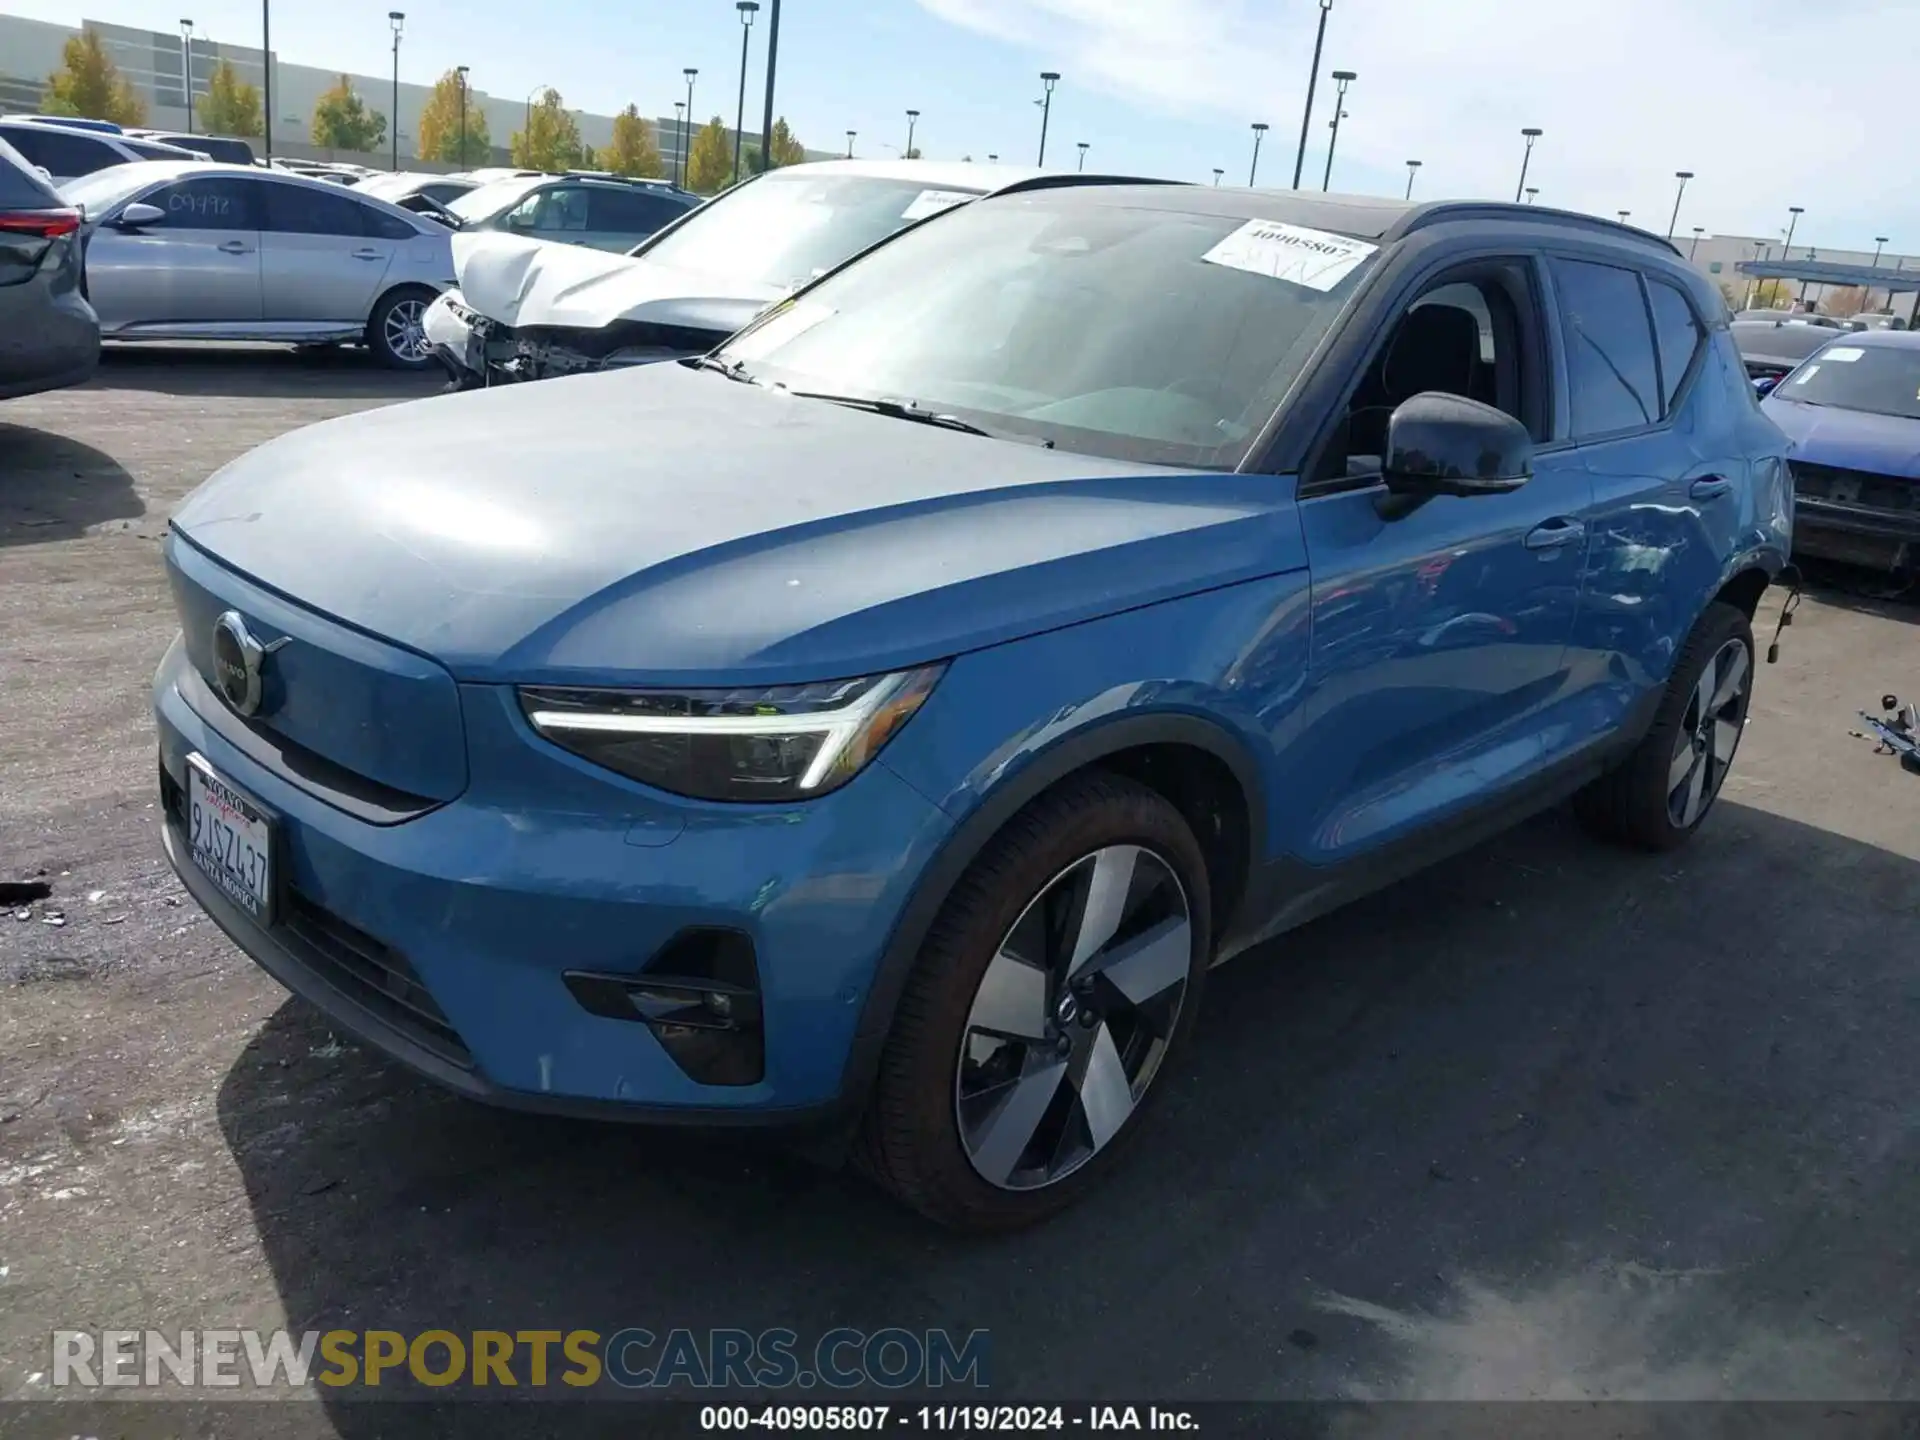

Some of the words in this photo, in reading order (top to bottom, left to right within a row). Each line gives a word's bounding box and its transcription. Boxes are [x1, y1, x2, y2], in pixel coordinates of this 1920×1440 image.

[192, 848, 221, 883] SANTA
[222, 871, 258, 916] MONICA
[193, 802, 267, 900] 9JSZ437
